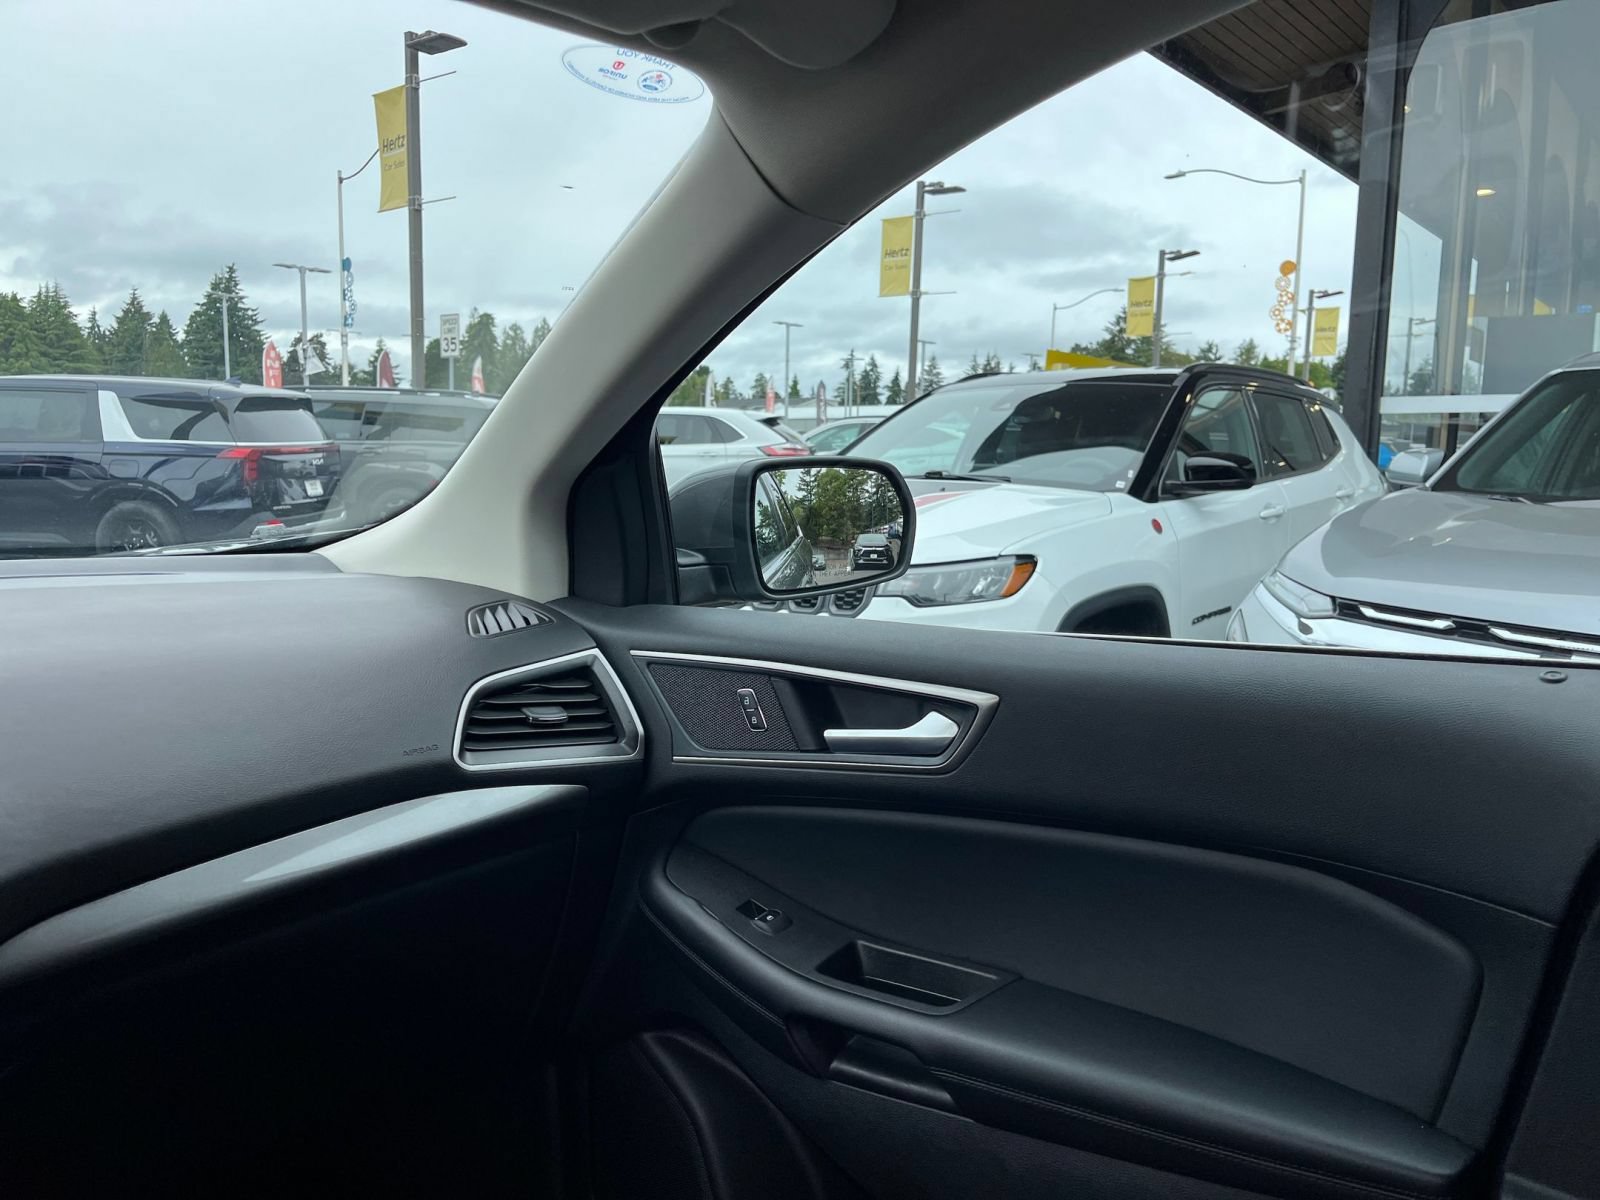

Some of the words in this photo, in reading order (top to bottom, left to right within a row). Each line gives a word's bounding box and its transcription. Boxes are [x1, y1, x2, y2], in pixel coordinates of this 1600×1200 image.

[382, 134, 405, 153] Hertz
[384, 163, 393, 171] Car
[884, 247, 909, 258] Hertz
[442, 318, 457, 326] SPEED
[442, 337, 457, 352] 35
[402, 744, 440, 757] AIRBAG
